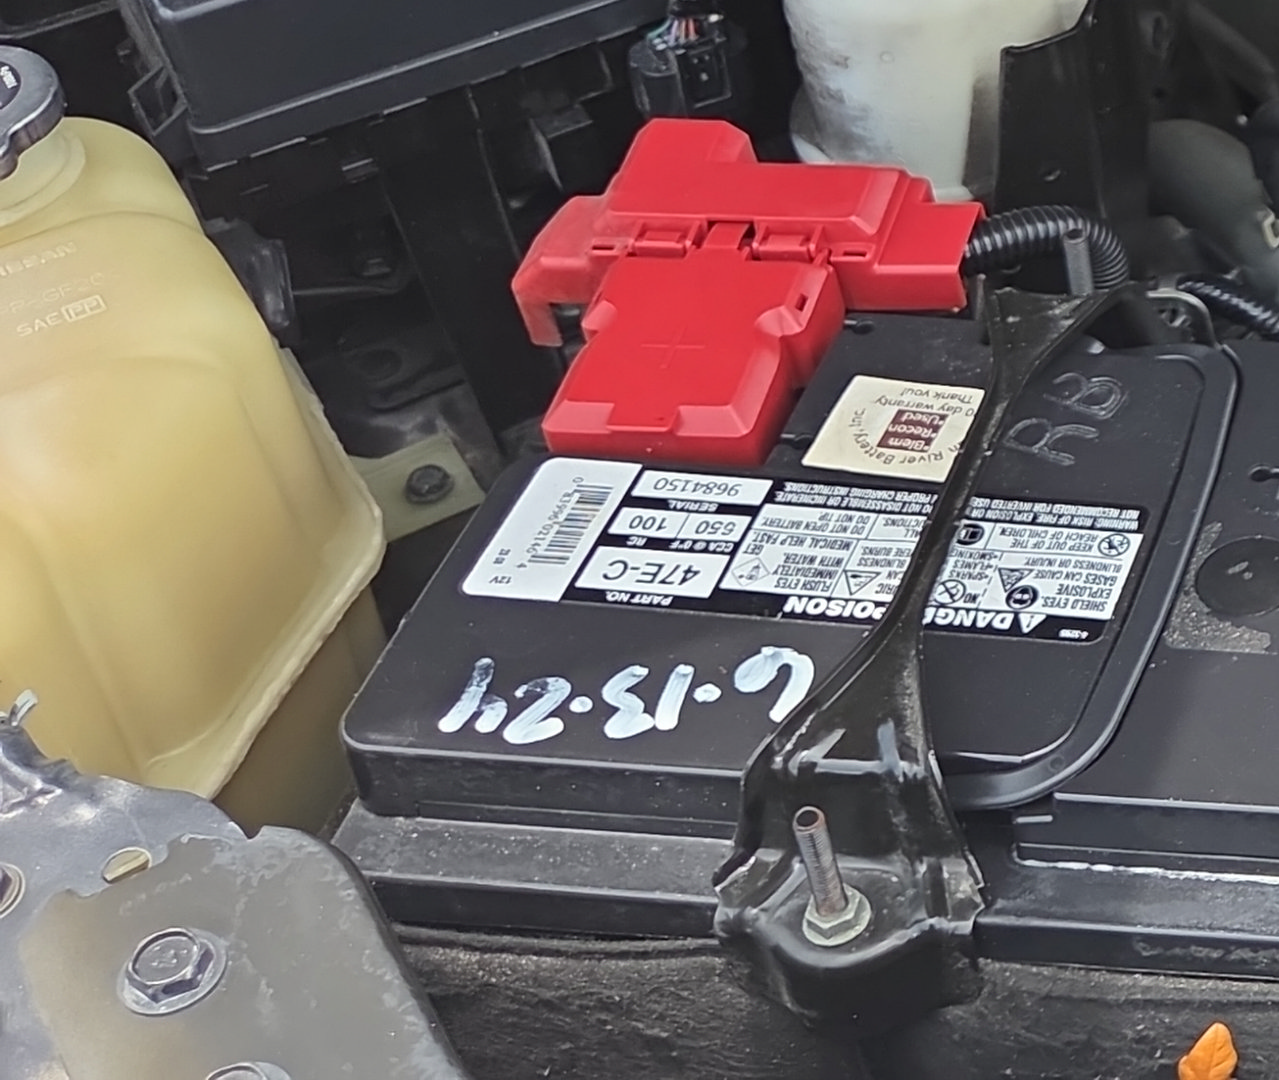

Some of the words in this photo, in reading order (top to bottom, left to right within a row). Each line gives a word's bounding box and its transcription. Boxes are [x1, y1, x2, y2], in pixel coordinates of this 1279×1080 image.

[16, 311, 63, 338] SAE
[900, 387, 929, 396] you!
[932, 389, 973, 404] Thank
[873, 394, 933, 410] warranty
[936, 402, 963, 415] day
[900, 411, 939, 424] Used
[887, 423, 932, 436] Recon
[852, 430, 895, 465] Battery,
[887, 436, 924, 448] Blem
[900, 450, 943, 465] River
[651, 476, 743, 497] 9684150
[848, 487, 896, 500] CHARGING
[892, 490, 932, 503] PROPER
[663, 498, 719, 512] SERIAL
[839, 496, 903, 511] DISASSEMBLE
[900, 502, 922, 513] NOT
[989, 498, 1033, 512] INVERTED
[1030, 501, 1053, 513] FOR
[816, 511, 835, 520] TIP.
[834, 512, 856, 522] NOT
[984, 508, 1035, 522] EXPLOSION
[1050, 502, 1121, 519] RECOMMENDED
[1118, 508, 1140, 520] NOT
[625, 514, 671, 531] 100
[758, 516, 804, 530] BATTERY.
[855, 514, 871, 524] DO
[1070, 515, 1094, 527] RISK
[692, 518, 737, 536] 650
[802, 521, 830, 532] OPEN
[829, 523, 850, 533] NOT
[849, 524, 866, 534] DO
[995, 525, 1049, 539] CHILDREN.
[624, 535, 648, 545] RC
[748, 532, 780, 544] FAST.
[778, 534, 807, 546] HELP
[806, 536, 854, 550] MEDICAL
[1008, 537, 1030, 548] THE
[1060, 530, 1098, 543] REACH
[705, 540, 735, 552] CCA
[741, 542, 765, 554] GET
[858, 544, 893, 557] BURNS.
[1028, 539, 1046, 549] OF
[1047, 540, 1068, 551] OUT
[1067, 541, 1093, 553] KEEP
[779, 552, 818, 565] WATER.
[816, 555, 845, 567] WITH
[855, 555, 907, 569] BLINDNESS
[1022, 555, 1058, 567] INJURY.
[1056, 558, 1072, 568] OR
[771, 563, 839, 579] IMMEDIATELY
[1071, 559, 1123, 572] BLINDNESS
[598, 558, 703, 587] 47E-C
[1032, 568, 1064, 580] CAUSE
[1061, 570, 1084, 582] CAN
[1082, 572, 1118, 586] GASES
[487, 574, 513, 585] 12V
[773, 576, 801, 589] EYES
[799, 579, 833, 591] FLUSH
[600, 590, 632, 601] NO.
[961, 591, 980, 604] NO
[1054, 583, 1113, 599] EXPLOSIVE
[630, 592, 674, 605] PART
[1037, 595, 1070, 609] EYES.
[1070, 597, 1108, 611] SHIELD
